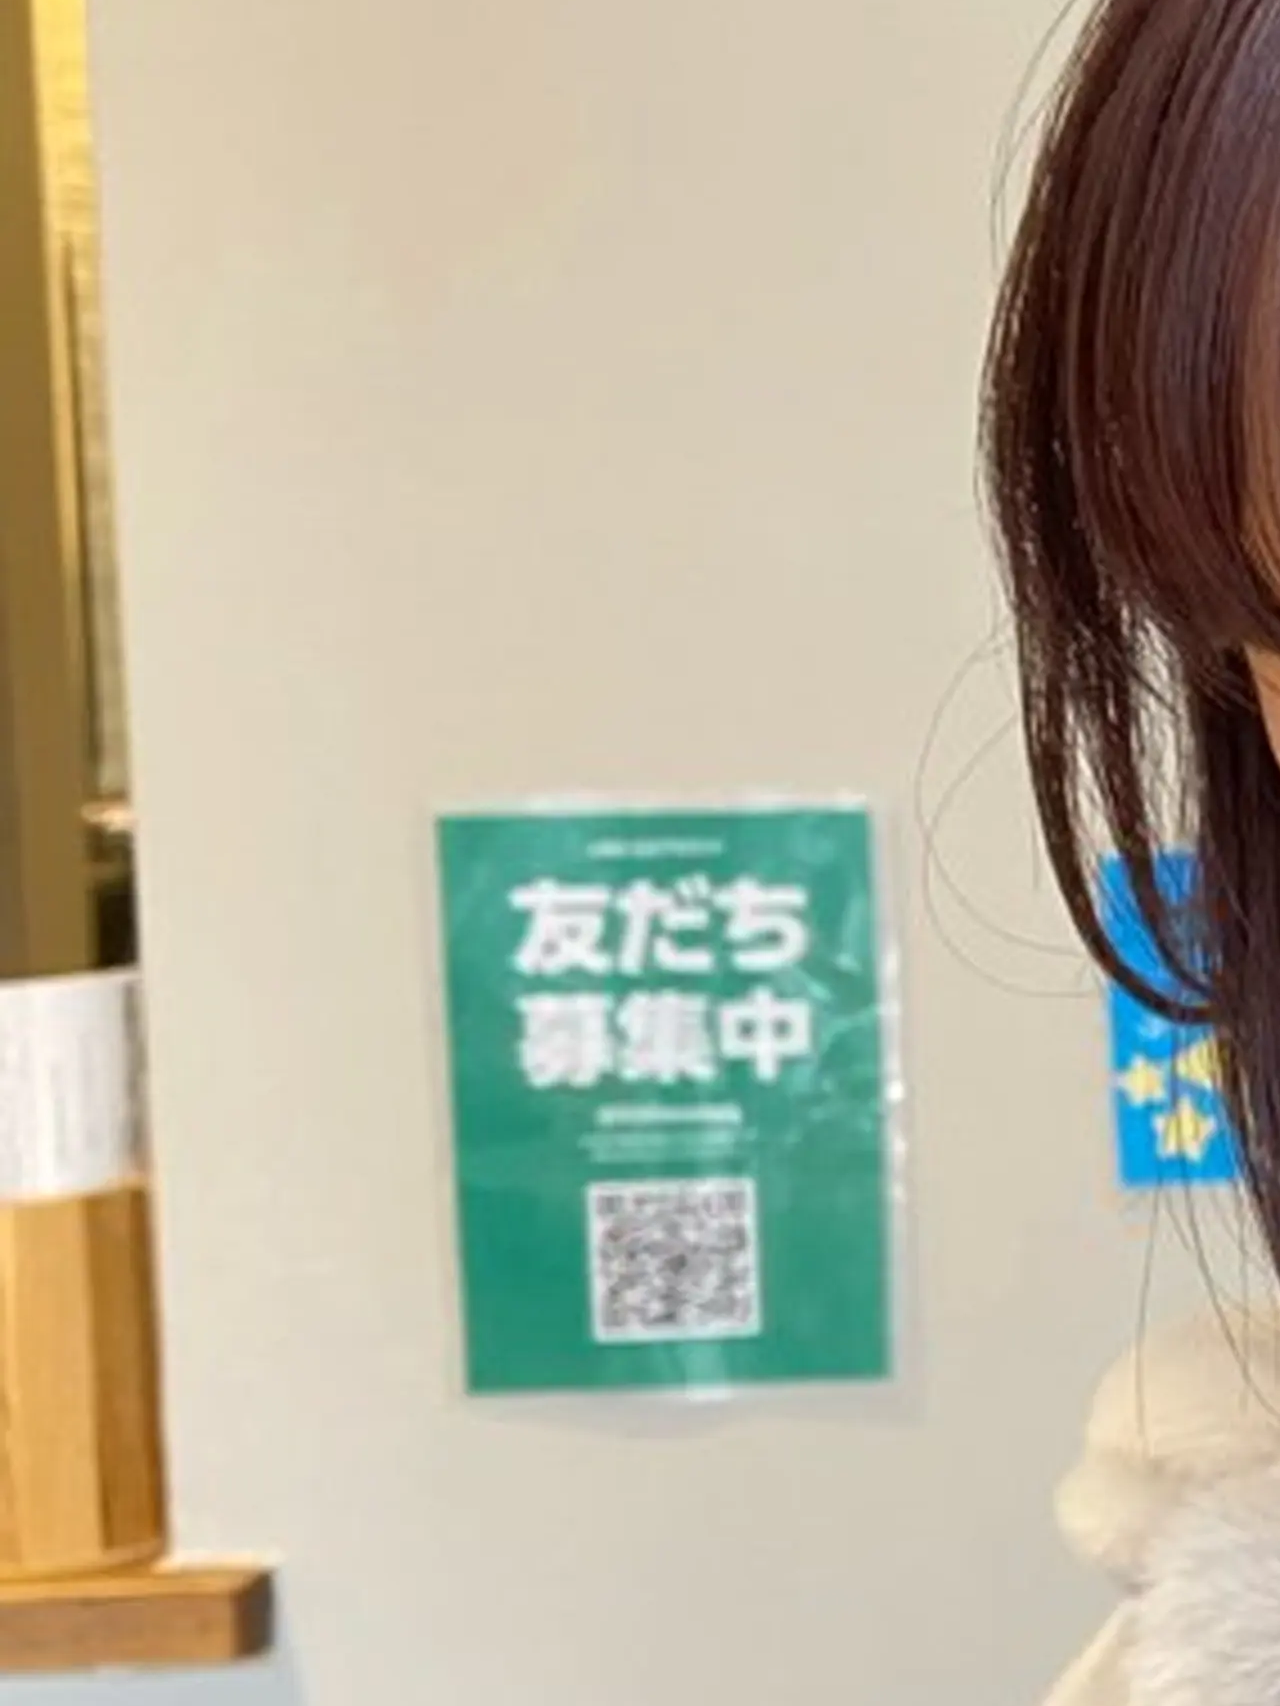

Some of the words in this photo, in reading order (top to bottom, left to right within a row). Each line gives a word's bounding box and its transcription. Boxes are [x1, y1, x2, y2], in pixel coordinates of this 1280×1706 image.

[509, 875, 808, 973] 友だち
[515, 986, 812, 1088] 募集中
